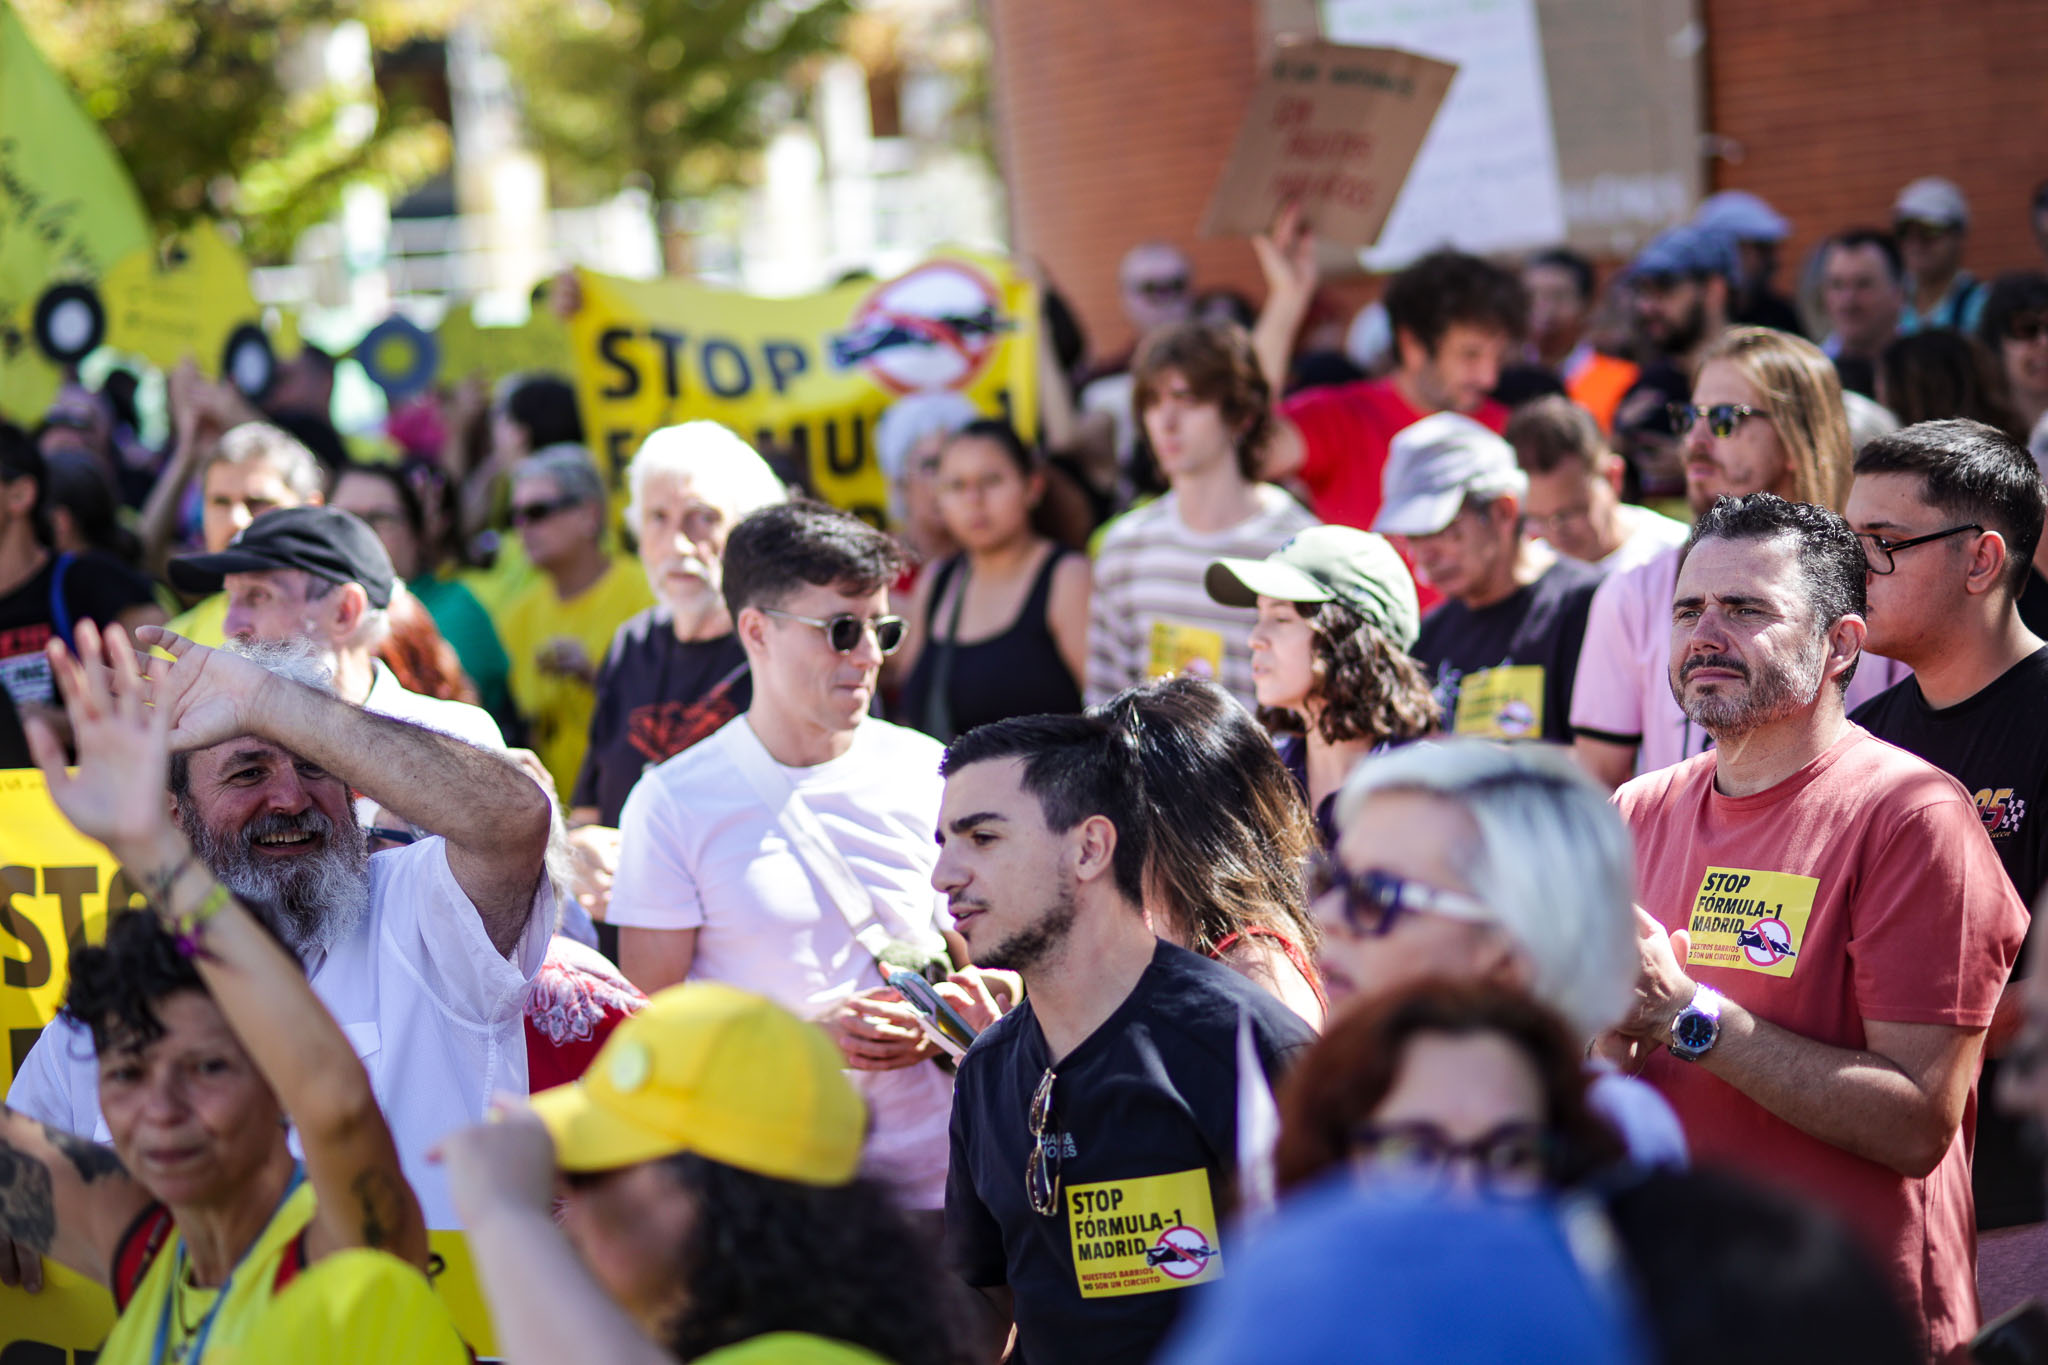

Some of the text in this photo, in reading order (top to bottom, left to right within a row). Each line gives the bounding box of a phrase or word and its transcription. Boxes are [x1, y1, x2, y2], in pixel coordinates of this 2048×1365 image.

[597, 328, 808, 399] STOP
[1974, 787, 2014, 830] 95
[1703, 872, 1751, 893] STOP
[1696, 892, 1783, 920] FÓRMULA-1
[1692, 915, 1745, 934] MADRID
[1690, 943, 1739, 953] UESTROS BARRIOS
[1693, 951, 1705, 959] SON
[1714, 953, 1741, 962] CIRCUITO
[1043, 1145, 1077, 1158] JOES
[1072, 1188, 1123, 1215] STOP
[1075, 1208, 1183, 1240] FÓRMULA-1
[1078, 1238, 1147, 1261] MADRID
[1081, 1267, 1154, 1282] NUESTROS BARRIOS
[1094, 1282, 1109, 1290] SON
[1123, 1276, 1160, 1287] CIRCUITO
